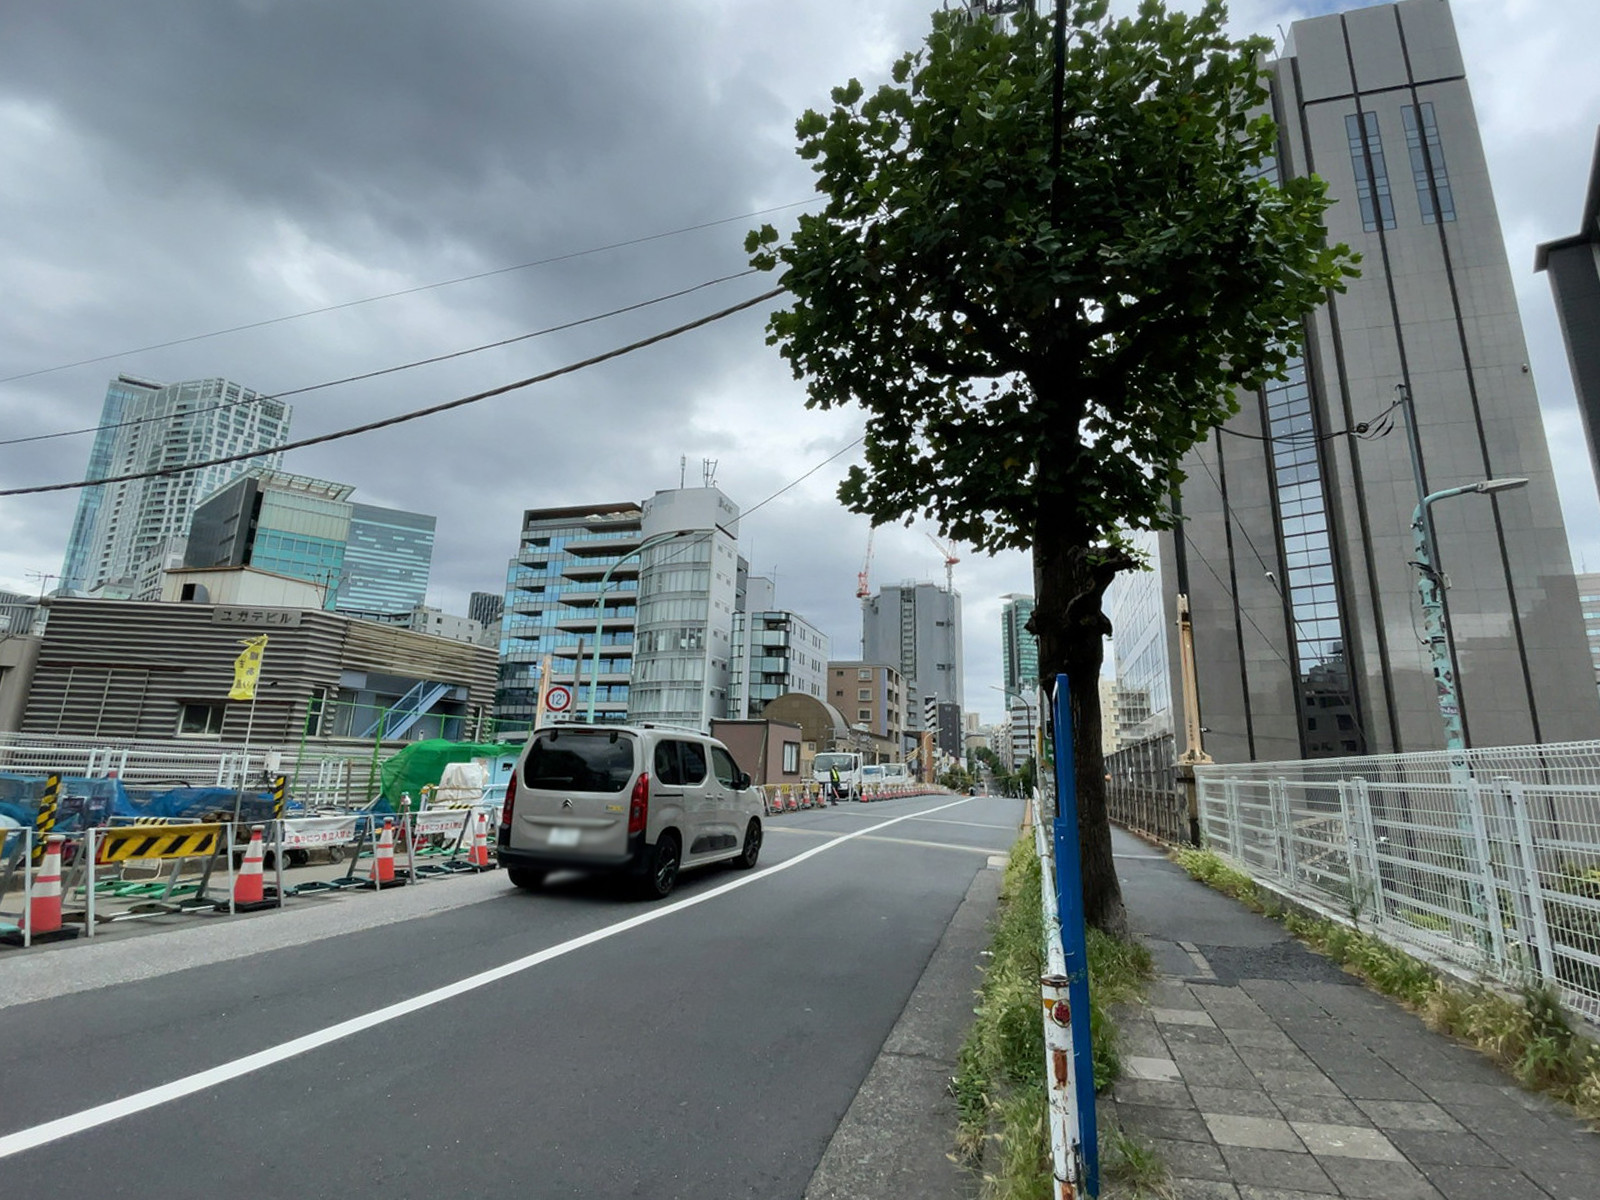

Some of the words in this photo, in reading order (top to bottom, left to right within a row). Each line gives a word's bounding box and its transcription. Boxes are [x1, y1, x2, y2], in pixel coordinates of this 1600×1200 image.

[221, 611, 293, 624] ユガテビル
